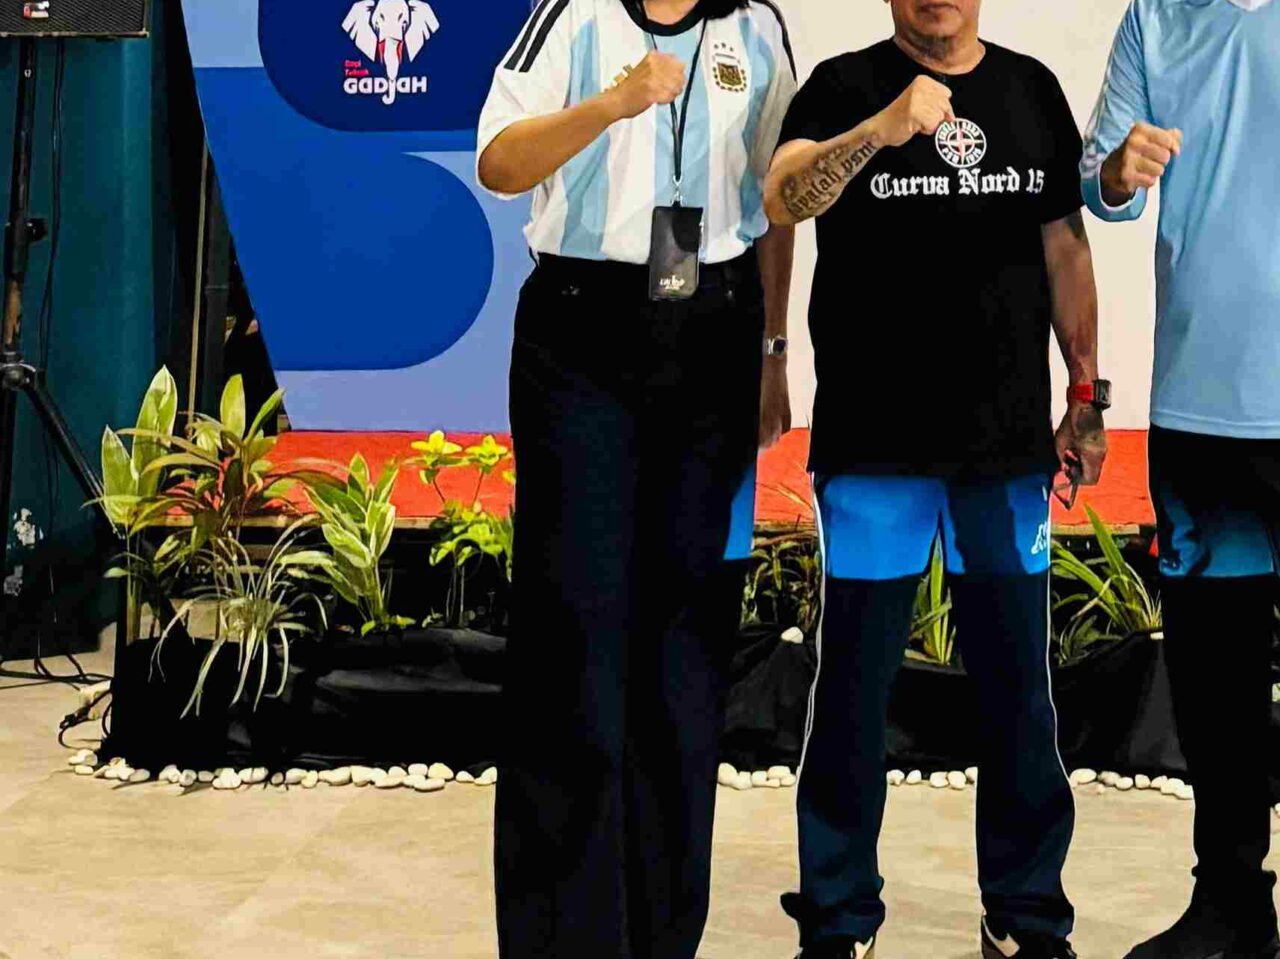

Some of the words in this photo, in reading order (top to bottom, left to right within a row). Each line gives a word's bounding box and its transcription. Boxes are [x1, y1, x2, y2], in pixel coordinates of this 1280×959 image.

[870, 172, 950, 199] Curva
[958, 166, 1020, 195] Nord
[1026, 168, 1045, 193] 15
